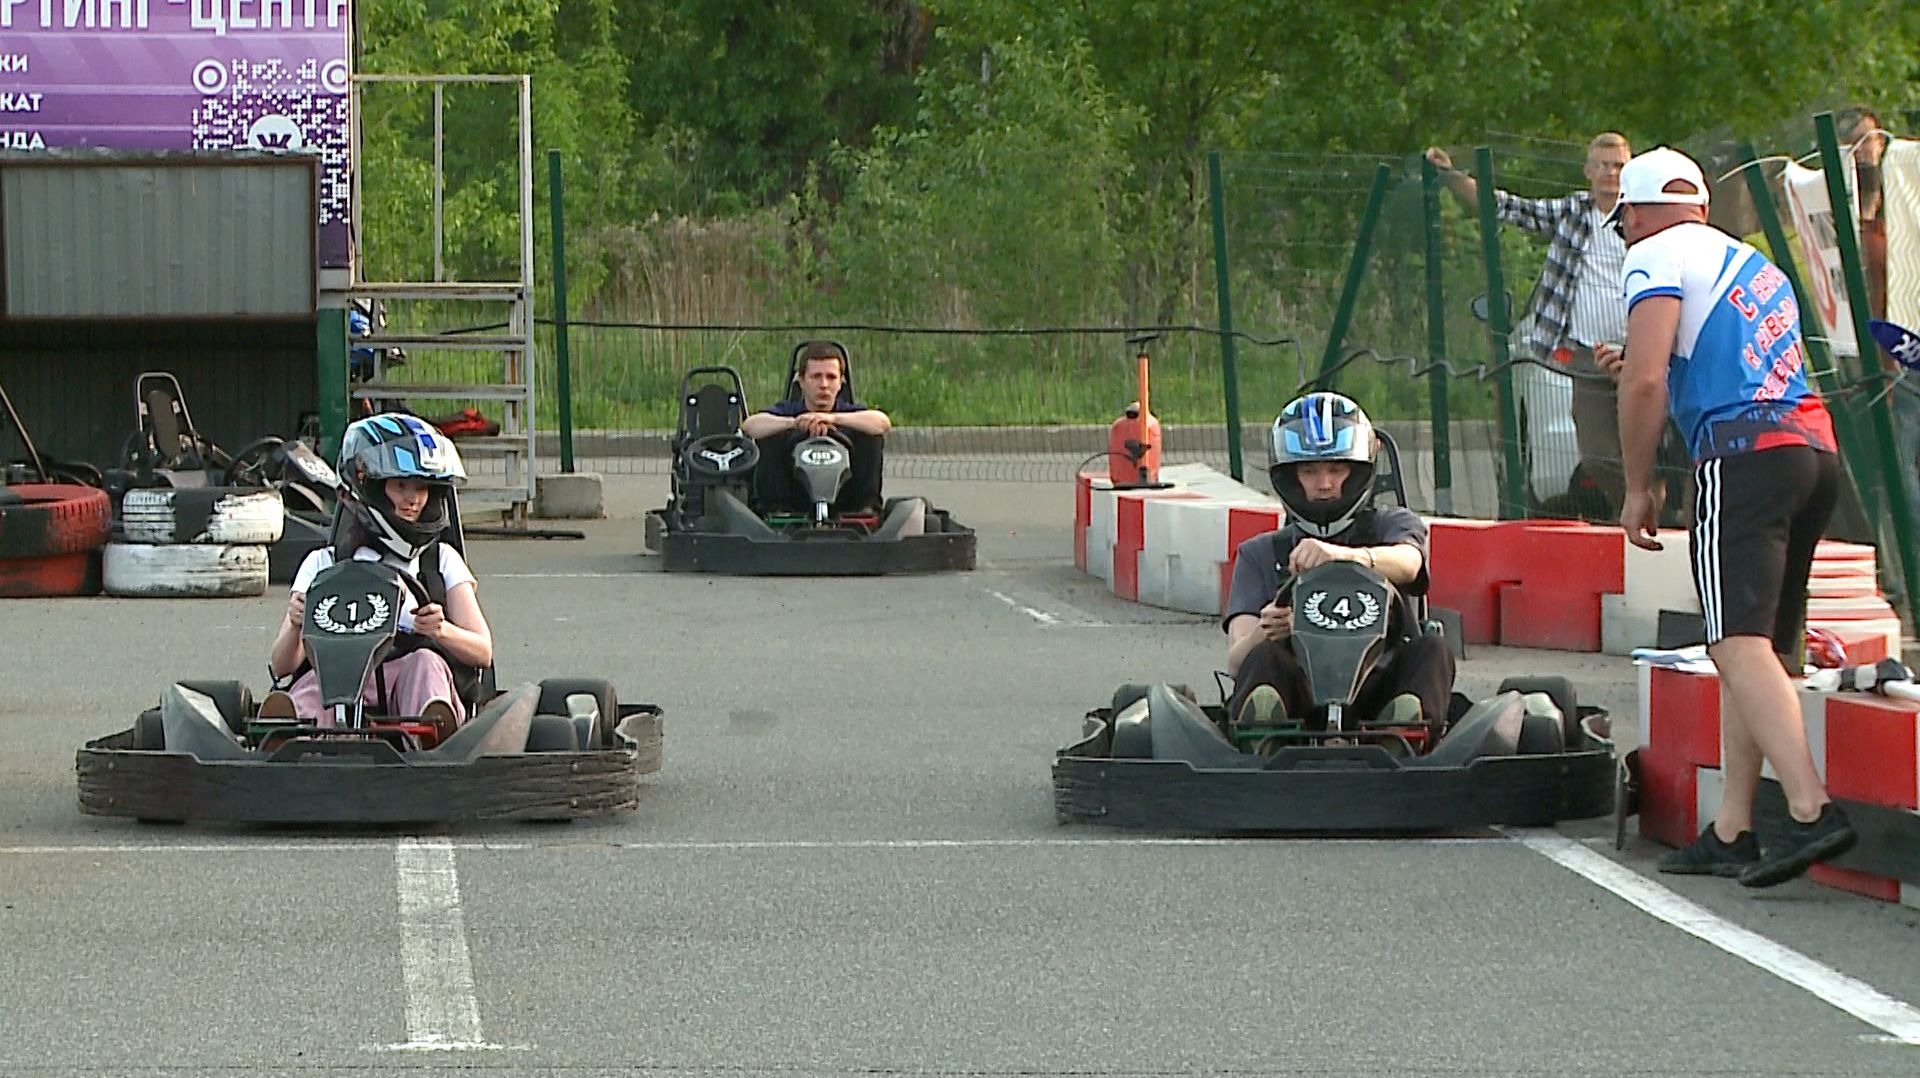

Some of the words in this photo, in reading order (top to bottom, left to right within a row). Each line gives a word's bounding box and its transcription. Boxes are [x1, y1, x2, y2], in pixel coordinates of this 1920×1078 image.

[0, 92, 44, 112] КАТ
[346, 602, 358, 622] 1
[1332, 598, 1351, 618] 4
